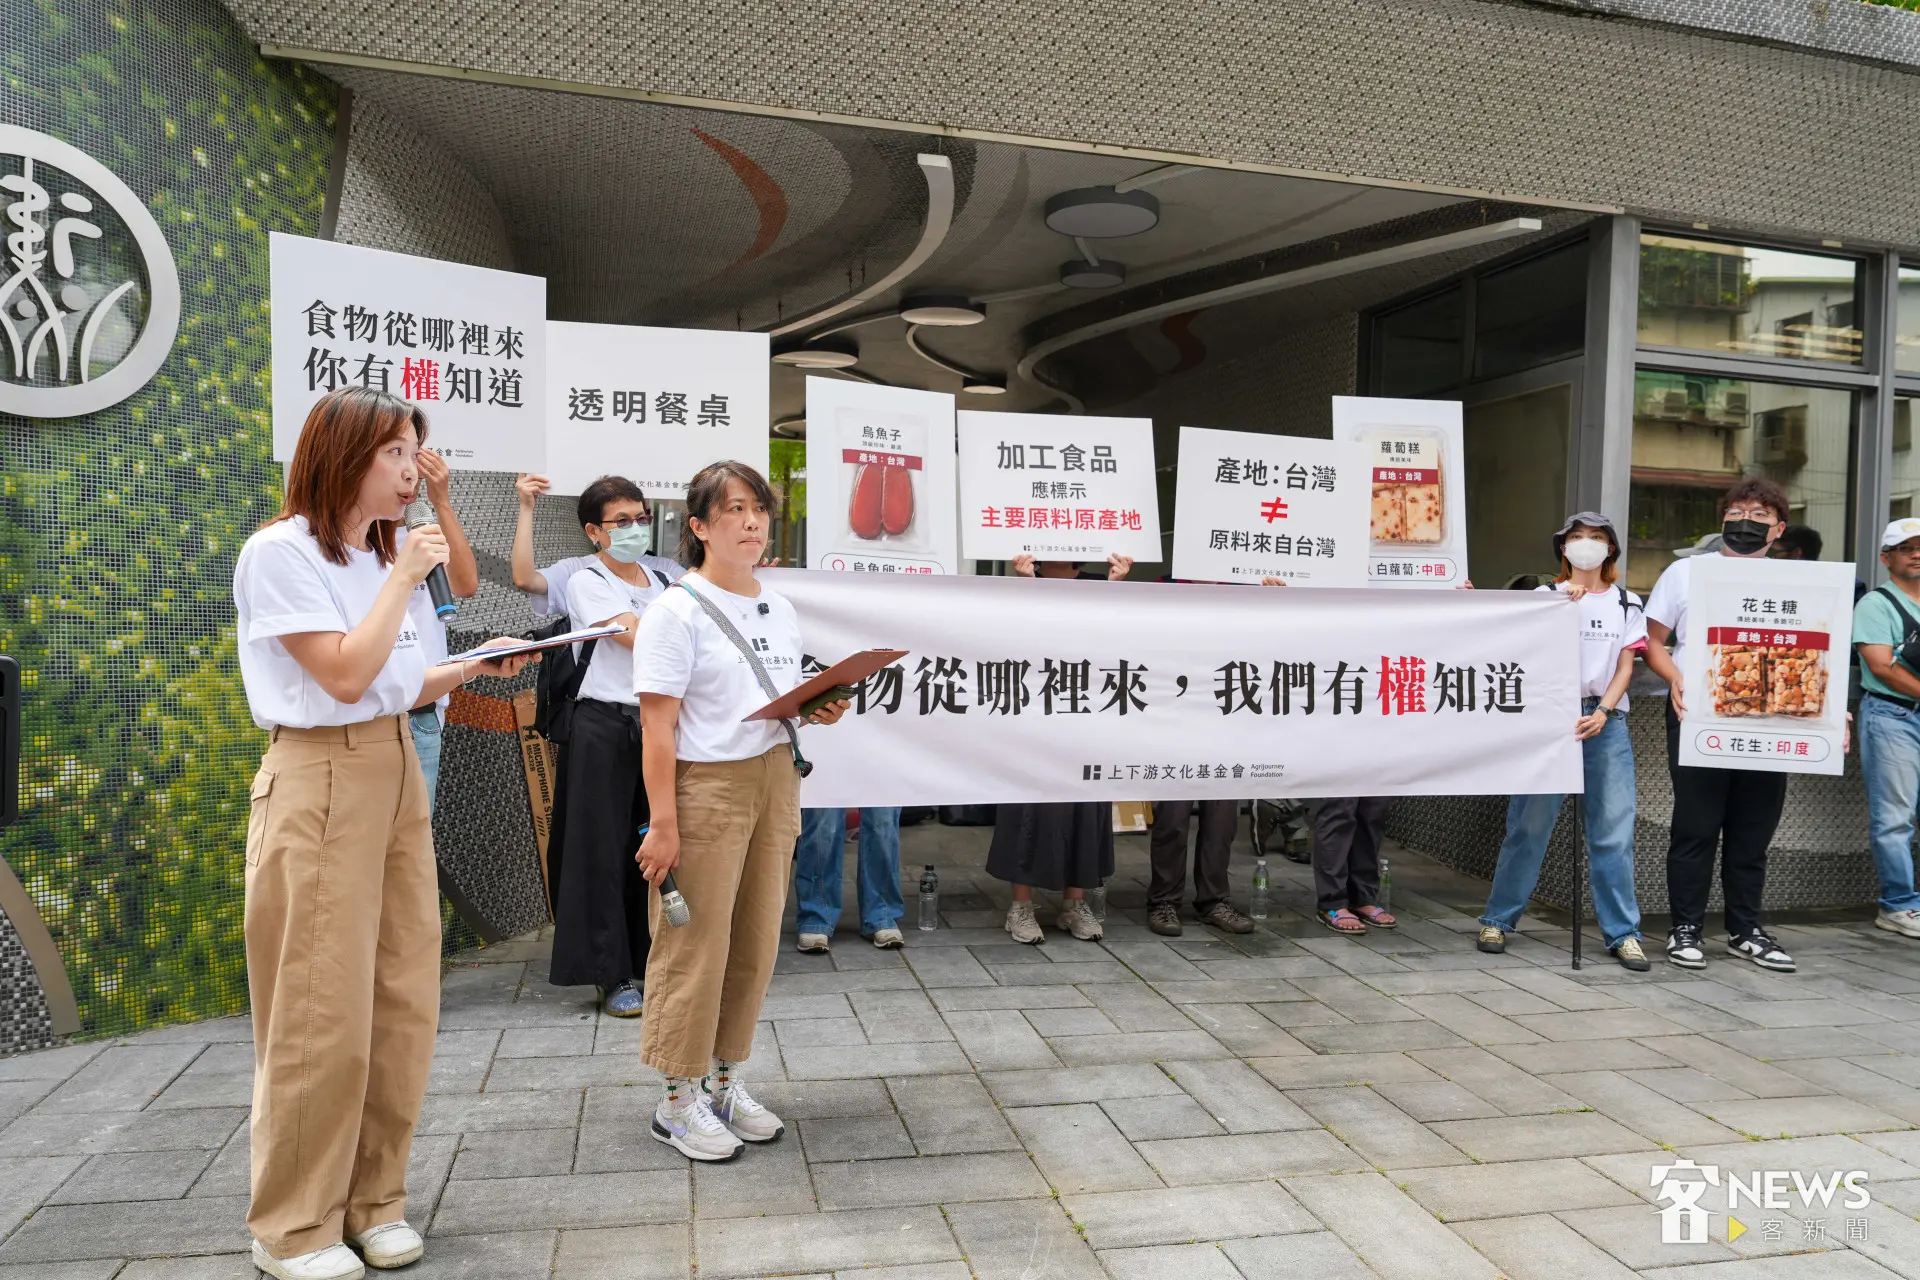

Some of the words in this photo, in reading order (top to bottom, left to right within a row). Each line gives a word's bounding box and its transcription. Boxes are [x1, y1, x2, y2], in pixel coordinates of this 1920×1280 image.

[302, 299, 525, 361] 食物從哪裡來
[302, 347, 525, 408] 你有權知道
[568, 387, 731, 427] 透明餐桌
[428, 447, 453, 457] 金會
[997, 441, 1118, 473] 加工食品
[1381, 441, 1420, 454] 蘿蔔糕
[859, 452, 906, 467] 產地：台灣
[1214, 457, 1337, 493] 產地：台灣
[1379, 470, 1422, 482] 產地：台灣
[1031, 480, 1087, 500] 應標示
[981, 505, 1143, 532] 主要原料原產地
[1209, 529, 1336, 559] 原料來自台灣
[1742, 597, 1798, 615] 花生糖
[1736, 631, 1798, 646] 產地：台灣
[1730, 738, 1810, 756] 花生：印度
[532, 743, 551, 804] MICROPHONE
[1108, 764, 1246, 780] 上下游文化基金會
